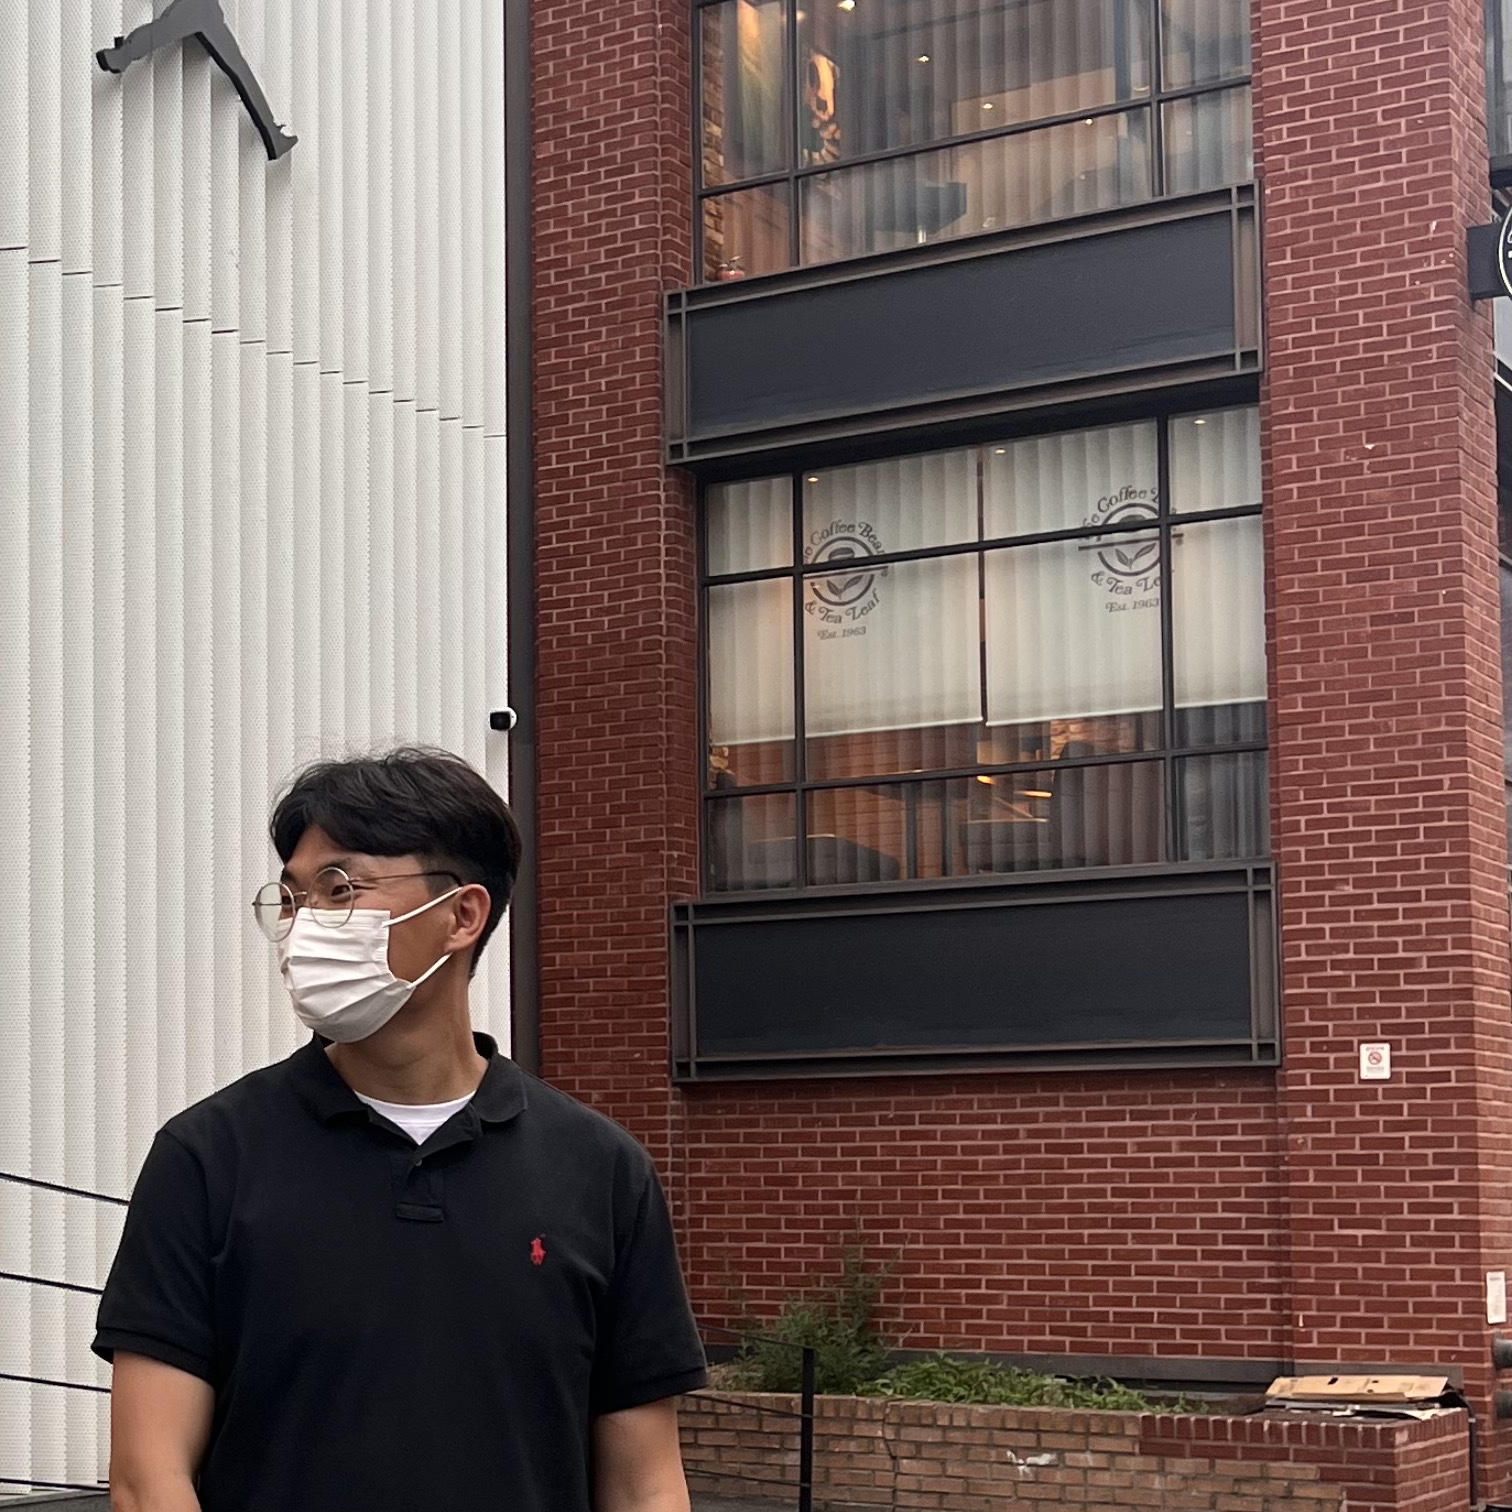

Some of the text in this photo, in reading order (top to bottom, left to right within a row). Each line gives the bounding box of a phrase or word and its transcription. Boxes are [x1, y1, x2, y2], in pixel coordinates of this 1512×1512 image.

[1097, 485, 1147, 513] Coffee
[810, 519, 856, 546] Coffee
[1090, 570, 1105, 586] &
[1106, 576, 1133, 595] Tea
[804, 587, 880, 624] & Tea Leaf
[1132, 597, 1160, 610] 1963
[841, 626, 867, 639] 1963
